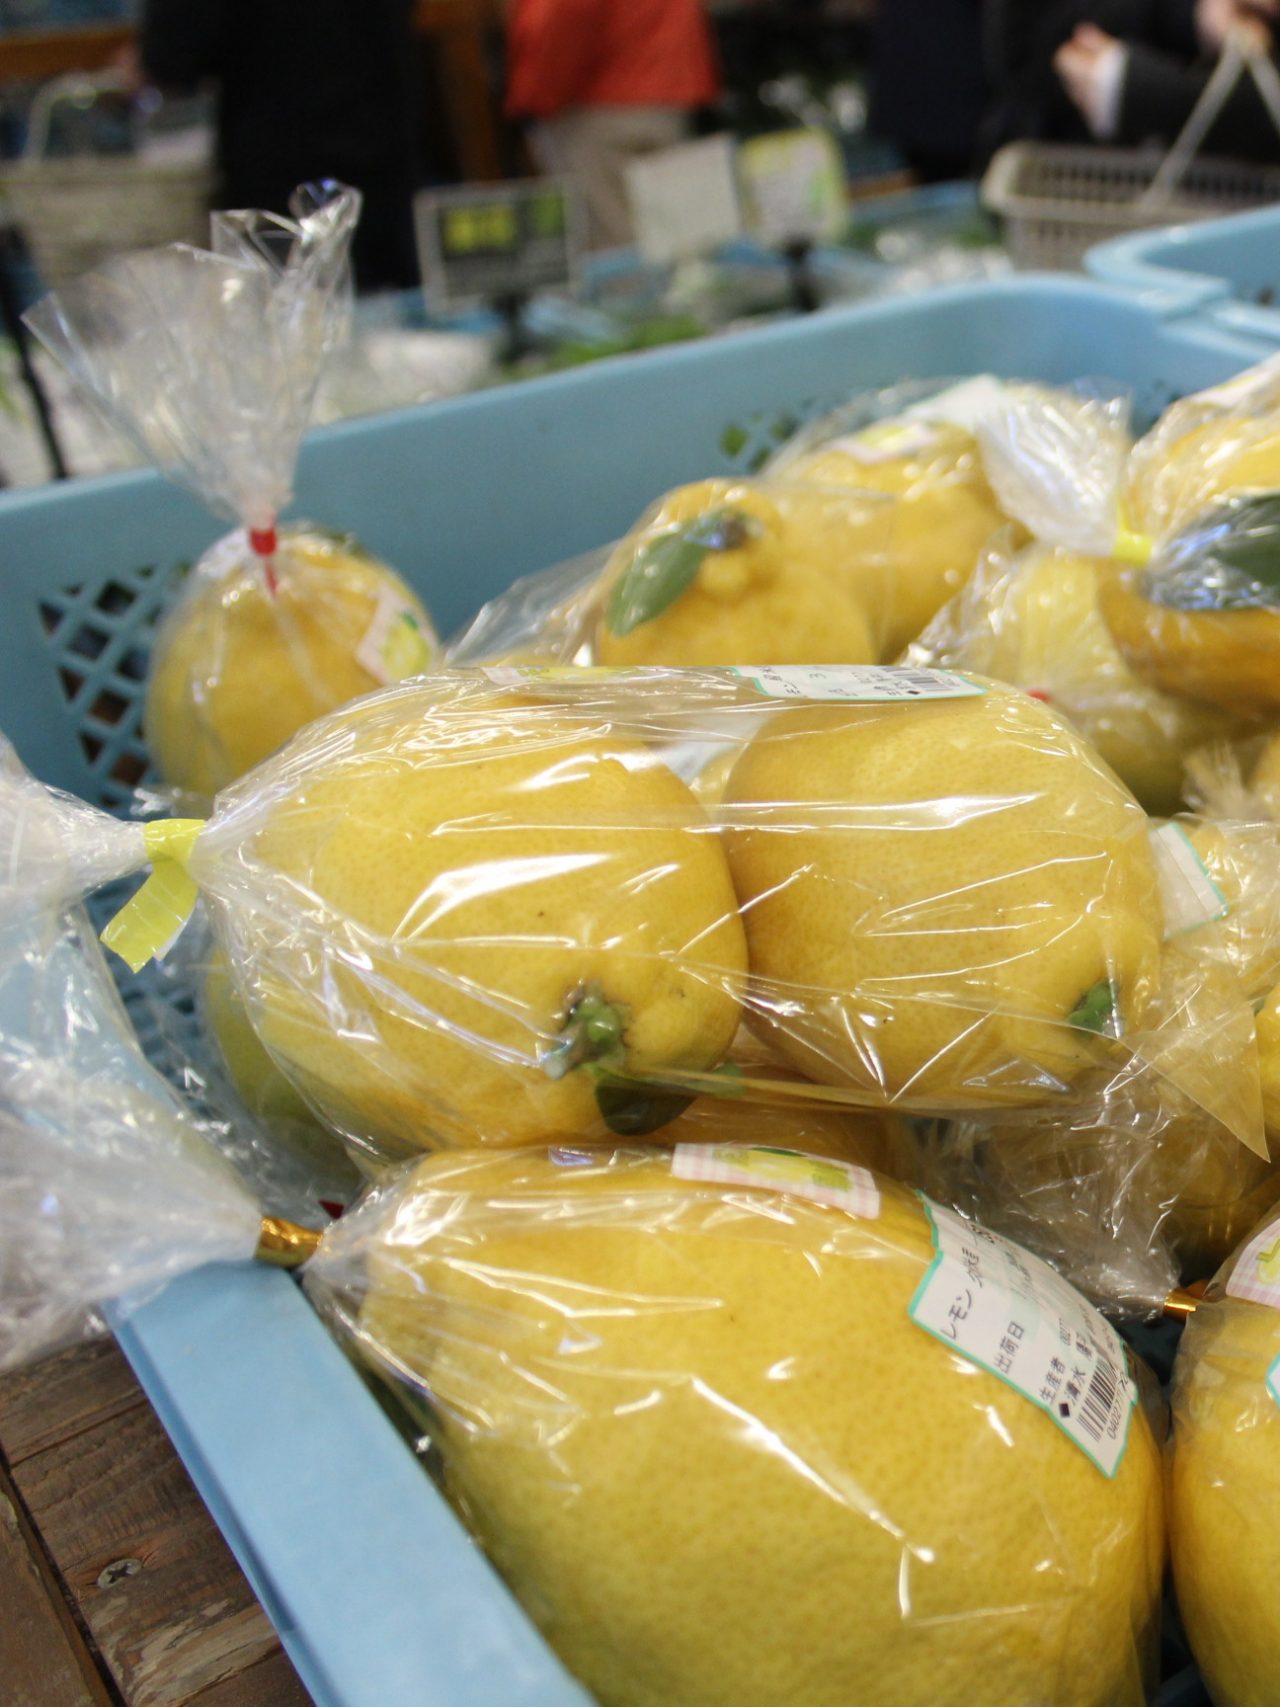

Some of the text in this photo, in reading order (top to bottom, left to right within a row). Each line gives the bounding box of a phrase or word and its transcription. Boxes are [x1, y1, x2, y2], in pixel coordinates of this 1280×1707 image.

[940, 1288, 973, 1340] レモン
[993, 1320, 1025, 1375] 出荷日
